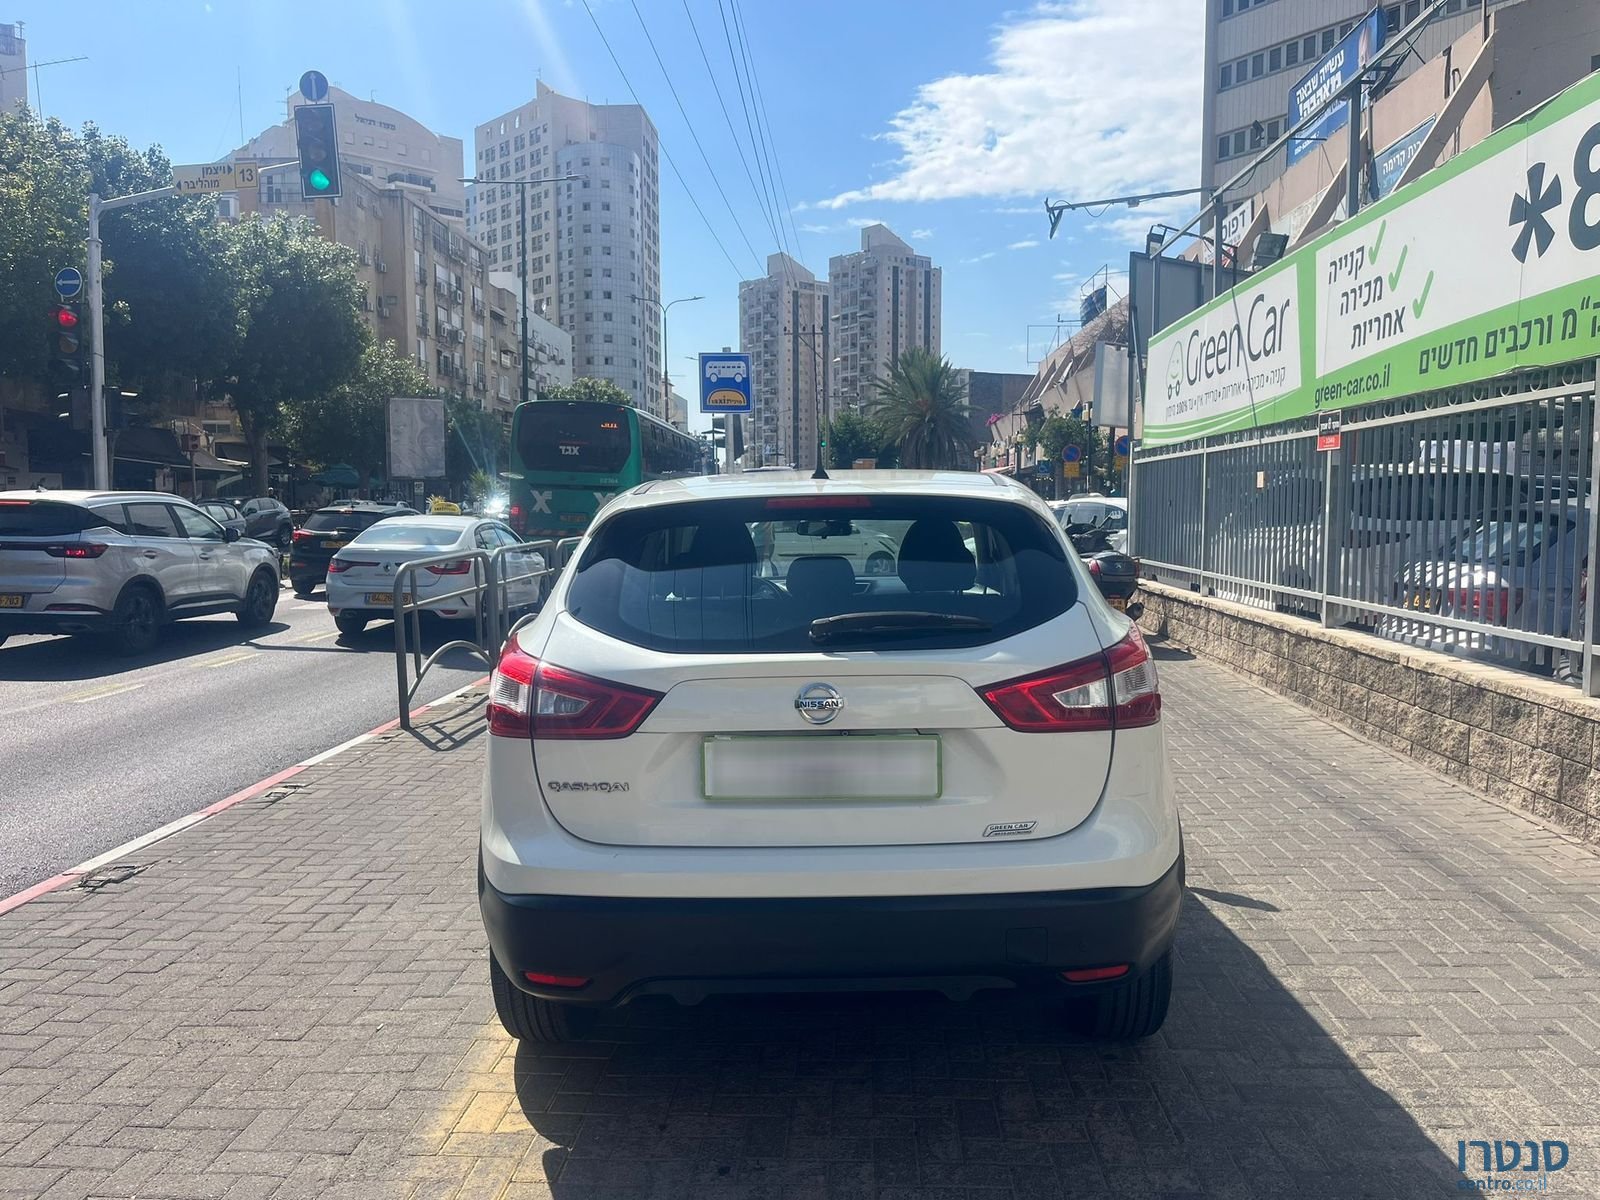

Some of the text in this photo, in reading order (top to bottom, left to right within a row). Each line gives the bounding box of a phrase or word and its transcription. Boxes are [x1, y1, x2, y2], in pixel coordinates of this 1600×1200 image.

[184, 177, 220, 190] מוהליבר
[202, 166, 226, 179] ויצמן
[240, 168, 254, 182] 13
[1329, 245, 1365, 285] קנייה
[1340, 275, 1383, 316] מכירה
[1351, 306, 1406, 350] אחריות
[1484, 314, 1553, 358] ורכבים
[1419, 336, 1478, 374] חדשים
[1270, 367, 1285, 387] קניה
[1315, 363, 1391, 408] green-car.co.il
[800, 700, 839, 708] NISSAN
[547, 781, 630, 793] QASHQAI
